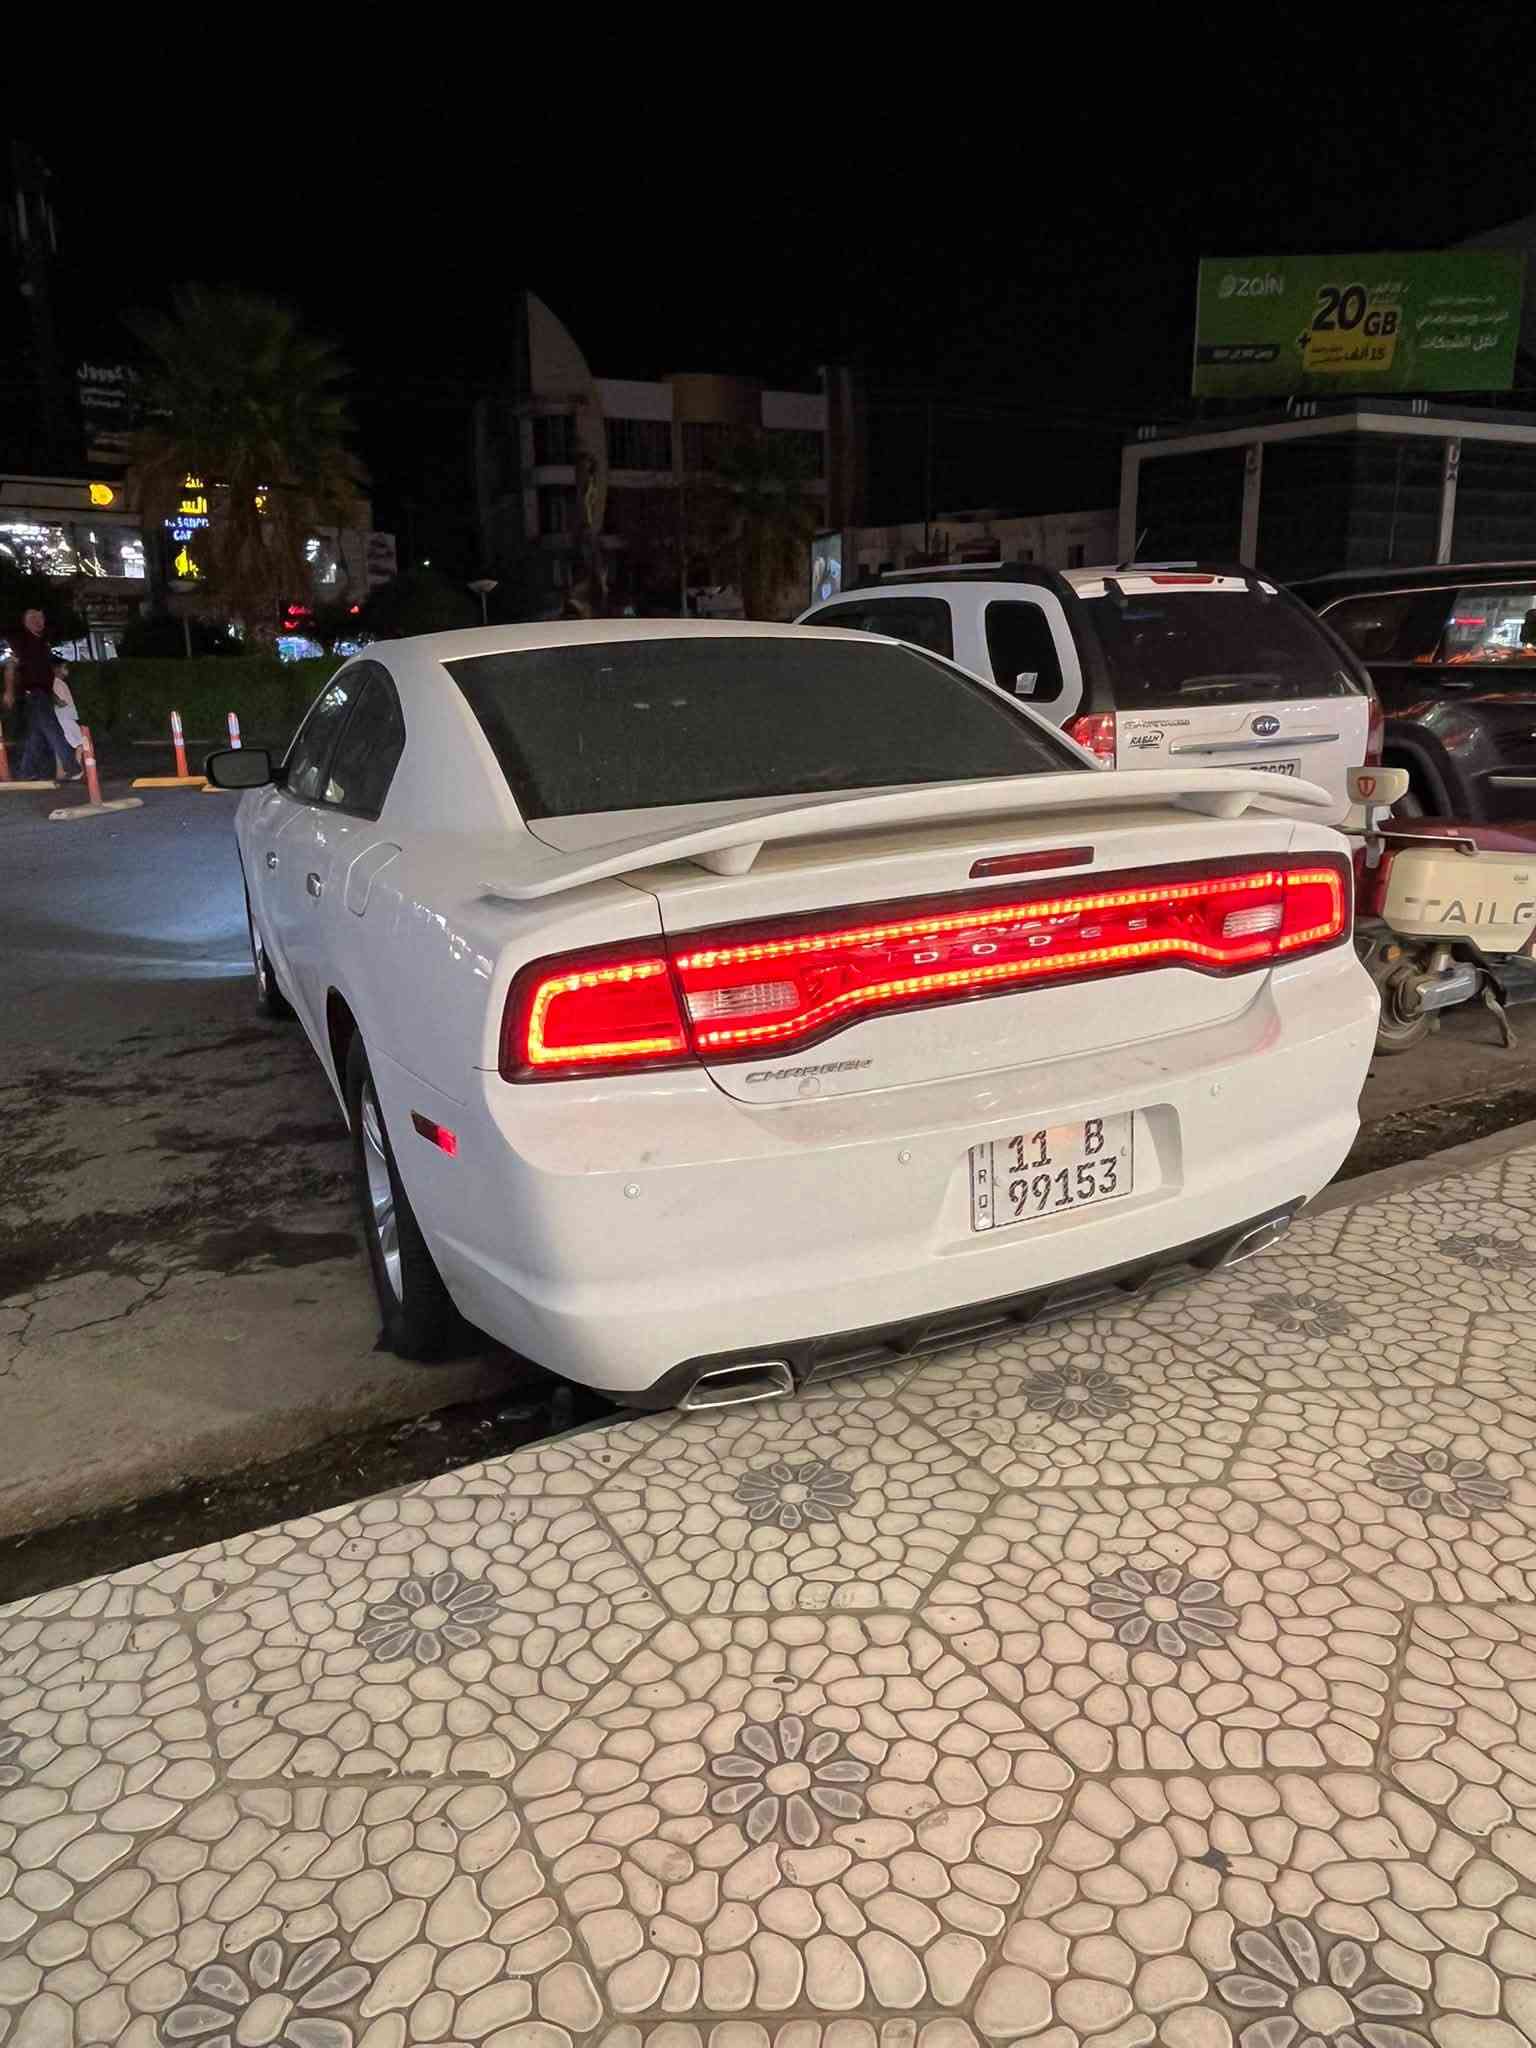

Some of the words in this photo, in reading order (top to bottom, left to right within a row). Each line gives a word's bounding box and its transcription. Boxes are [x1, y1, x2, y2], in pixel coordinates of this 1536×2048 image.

[1311, 285, 1367, 331] 20
[1363, 311, 1398, 337] GB
[1404, 897, 1536, 925] TAILG
[914, 918, 1148, 965] DODGE
[745, 1058, 873, 1084] CHARGER
[1008, 1129, 1052, 1174] 11
[1084, 1117, 1105, 1156] B
[1008, 1156, 1118, 1217] 99153
